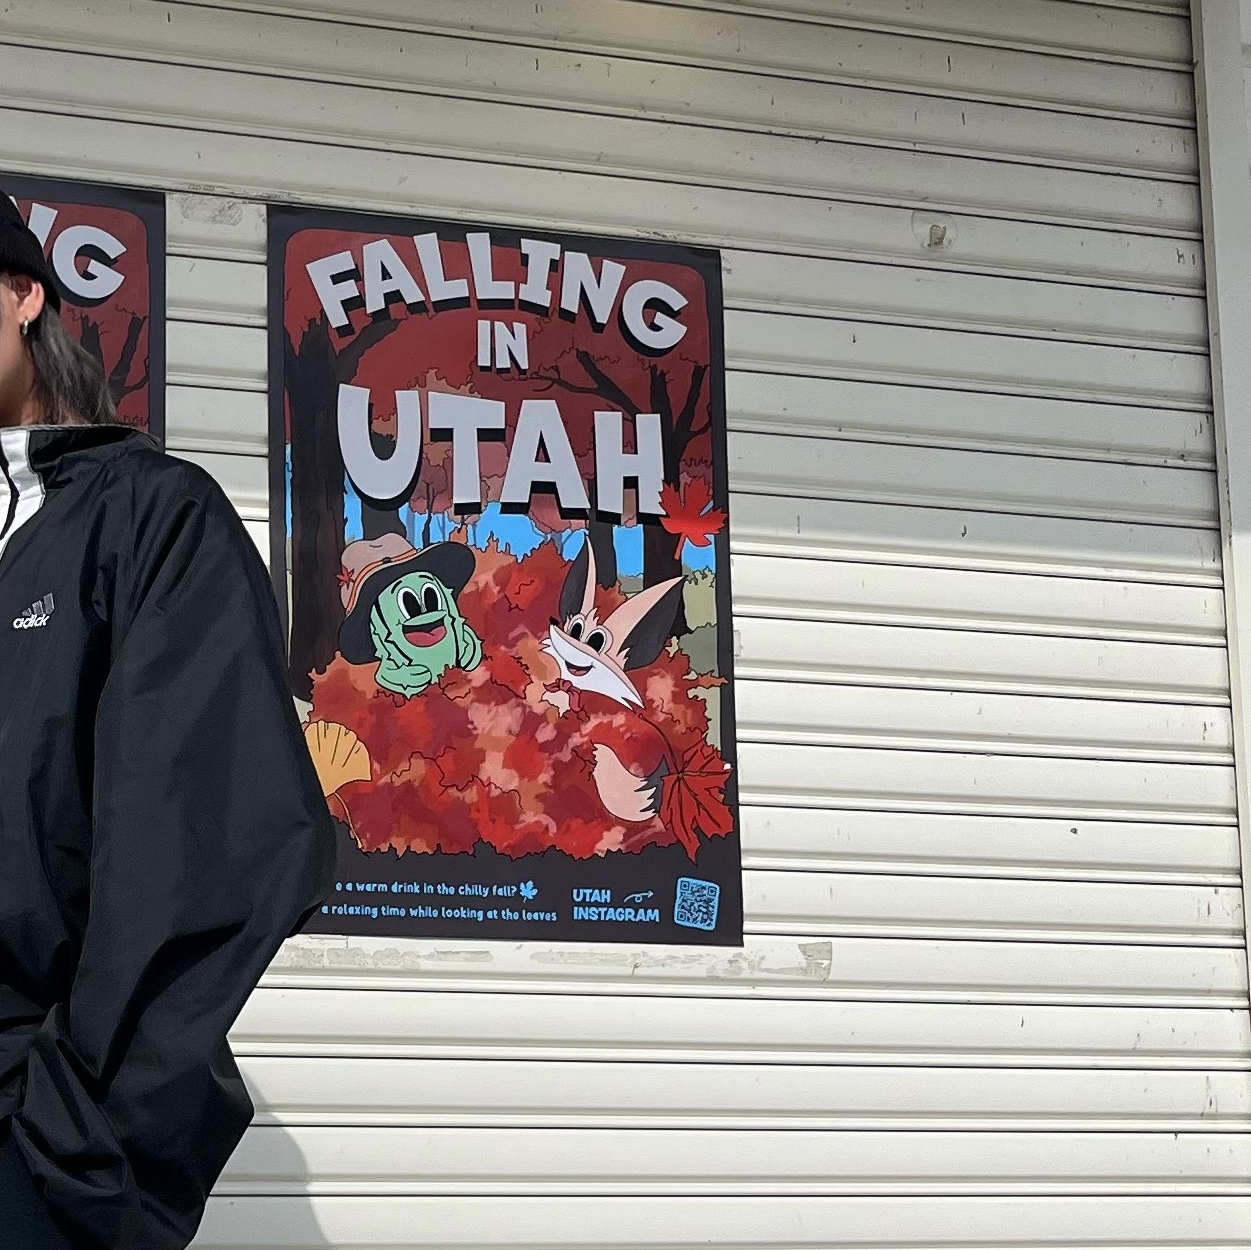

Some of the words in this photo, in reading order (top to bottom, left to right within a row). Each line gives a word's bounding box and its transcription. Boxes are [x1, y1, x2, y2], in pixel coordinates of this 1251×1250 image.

[305, 232, 689, 350] FALLING
[476, 319, 530, 371] IN
[336, 383, 666, 518] UTAH
[345, 882, 353, 892] a
[355, 882, 389, 893] warm
[391, 881, 421, 894] drink
[423, 882, 435, 894] in
[436, 882, 456, 895] the
[458, 883, 490, 897] chilly
[492, 884, 518, 897] fall?
[572, 888, 611, 903] UTAH
[321, 905, 329, 914] a
[331, 903, 378, 919] relaxing
[381, 904, 406, 917] time
[409, 905, 439, 918] while
[441, 906, 484, 922] looking
[486, 909, 498, 920] at
[501, 907, 520, 921] the
[522, 909, 557, 922] leaves
[573, 906, 660, 923] INSTAGRAM
